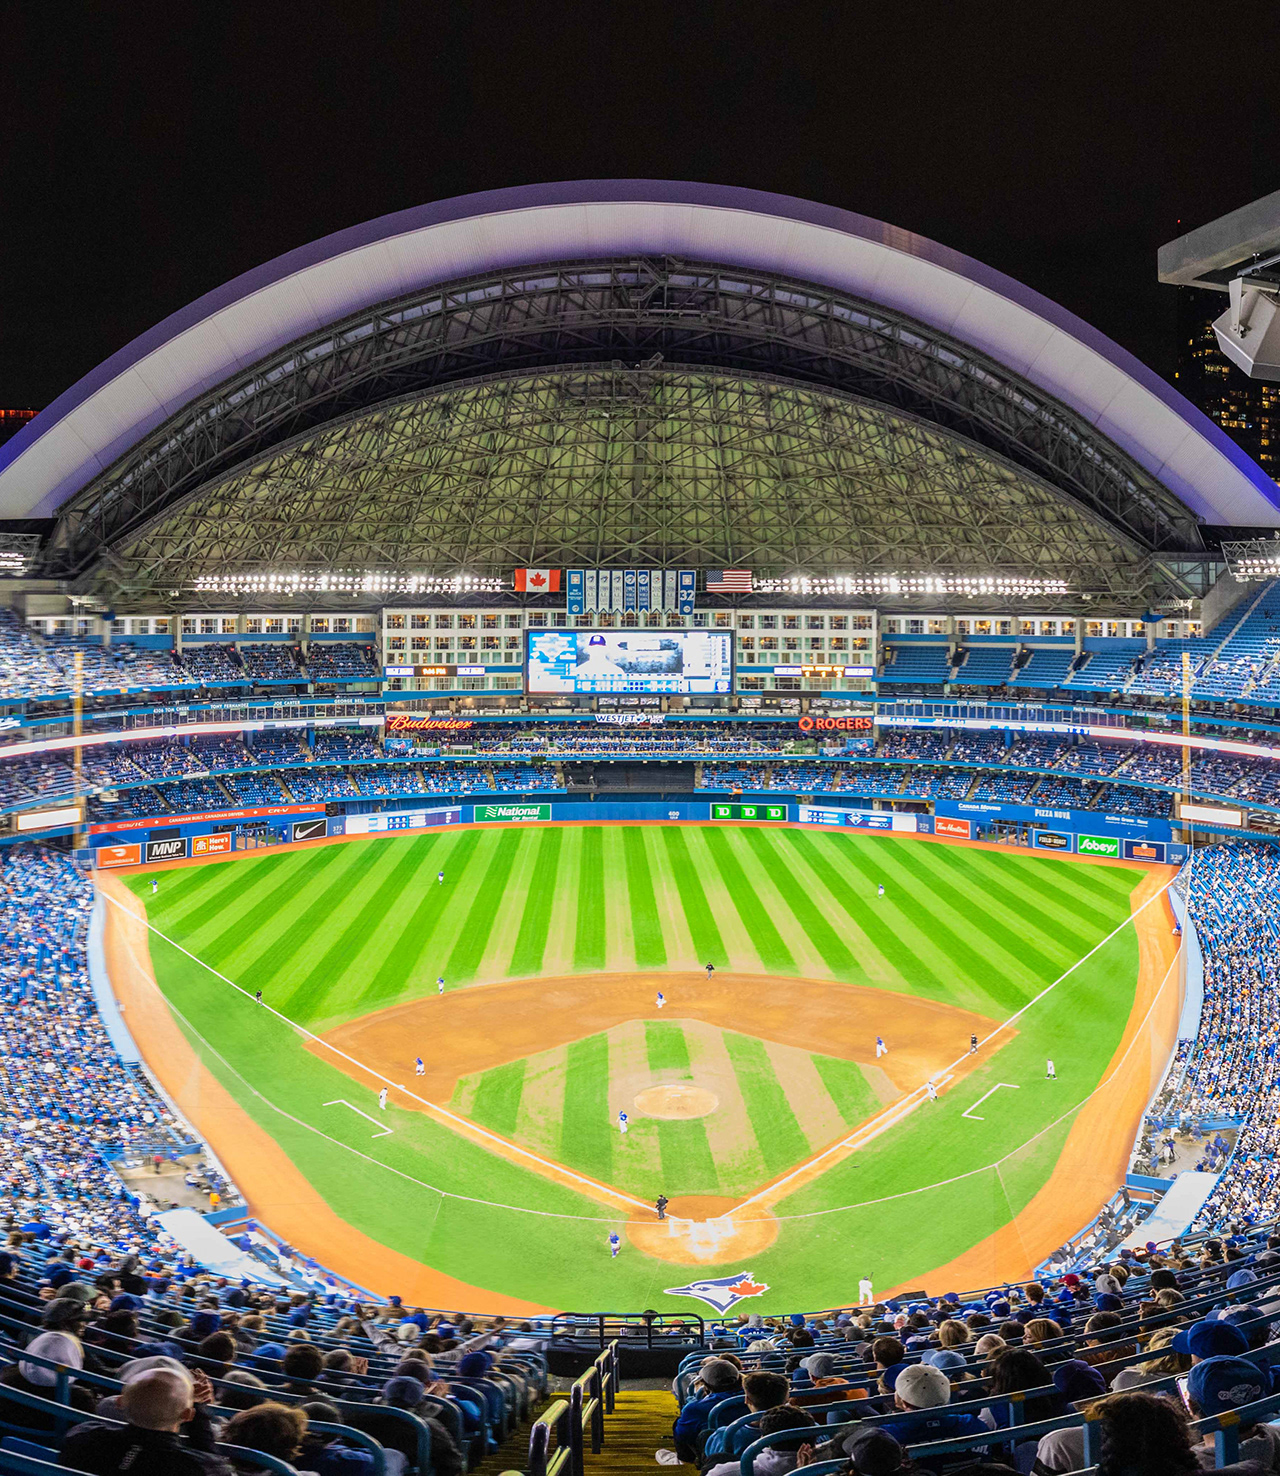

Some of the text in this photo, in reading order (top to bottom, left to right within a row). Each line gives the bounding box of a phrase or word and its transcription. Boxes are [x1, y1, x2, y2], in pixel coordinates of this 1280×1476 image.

[680, 590, 694, 600] 32
[387, 715, 472, 730] Budweiser
[597, 714, 636, 723] WESTJET
[816, 717, 872, 730] ROGERS
[498, 806, 540, 816] National
[717, 808, 730, 816] TD
[742, 808, 755, 816] TD
[768, 808, 781, 816] TD
[1035, 808, 1070, 820] PIZZA NOVA
[936, 822, 947, 830] Tim
[947, 824, 968, 834] Hortons
[152, 842, 182, 856] MNP
[1080, 838, 1116, 853] Sobeys
